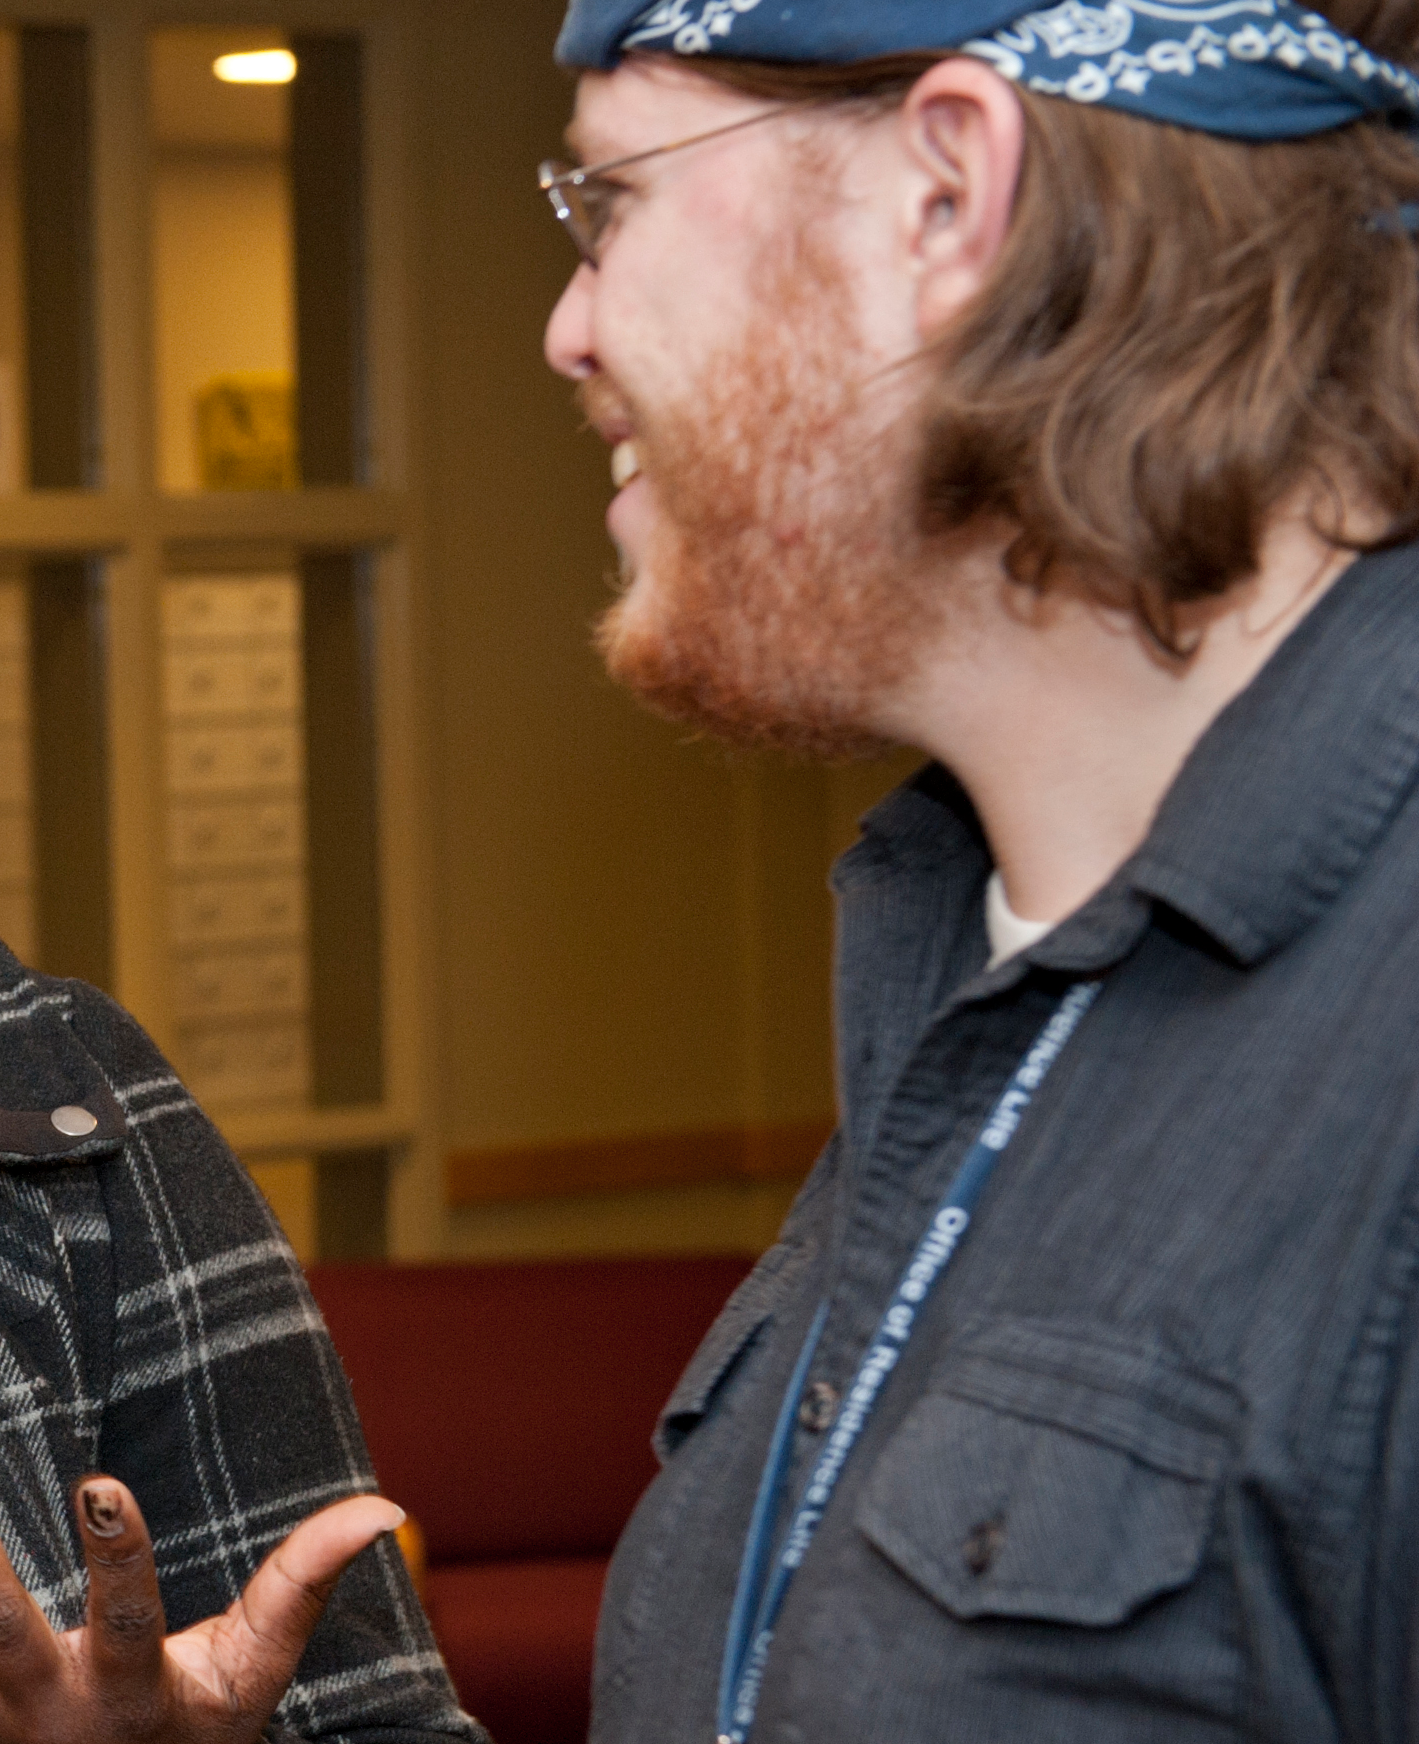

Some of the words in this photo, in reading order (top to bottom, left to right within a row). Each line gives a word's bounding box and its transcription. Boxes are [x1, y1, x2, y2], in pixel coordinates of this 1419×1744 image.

[899, 1206, 970, 1302] Office
[881, 1304, 914, 1341] of
[806, 1345, 900, 1504] Residence
[780, 1510, 823, 1568] Life
